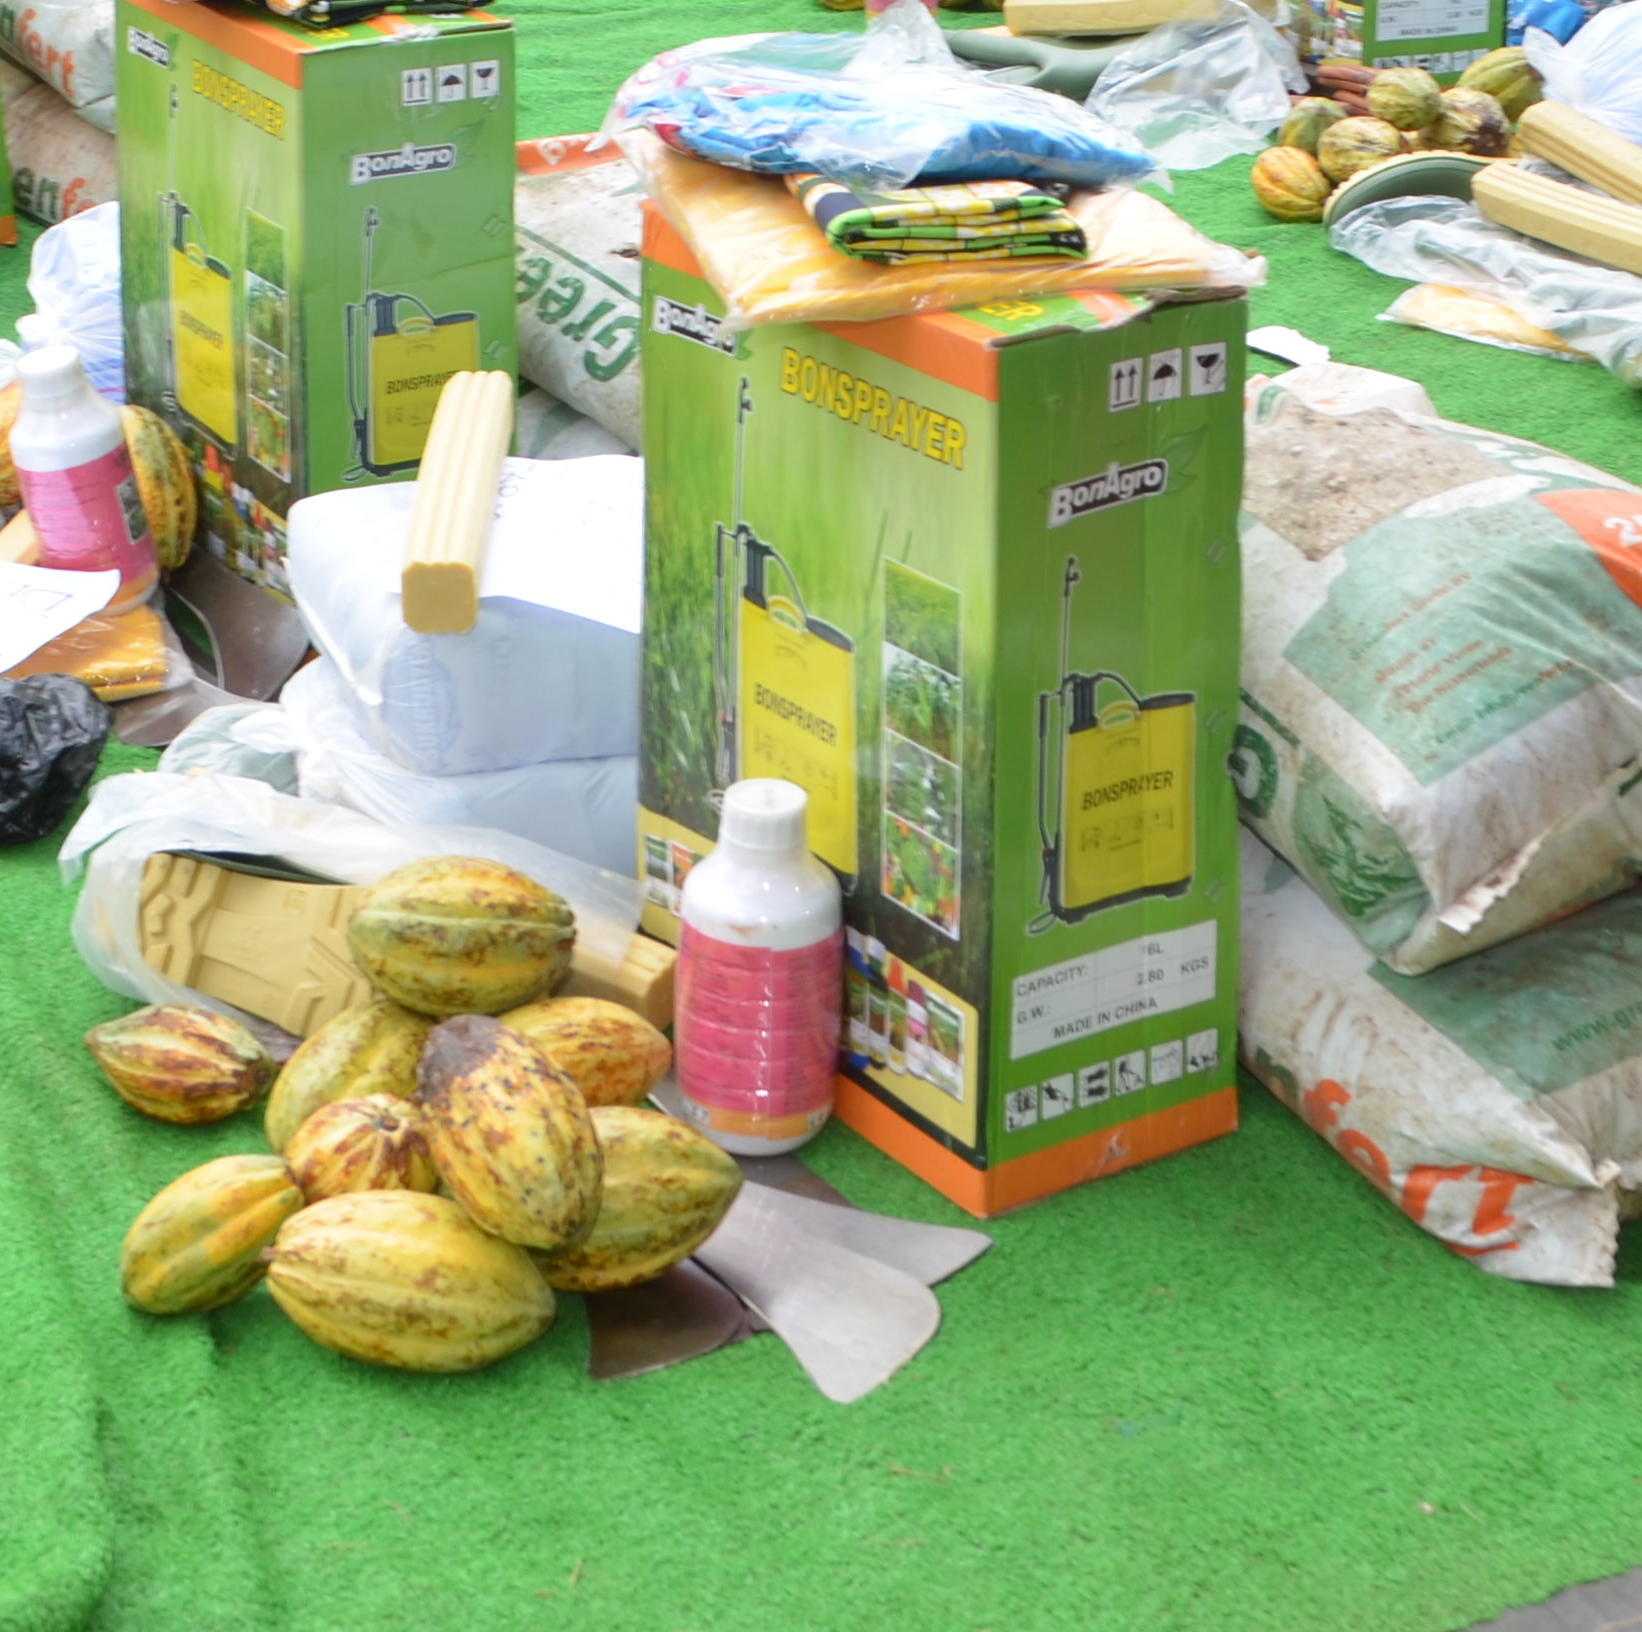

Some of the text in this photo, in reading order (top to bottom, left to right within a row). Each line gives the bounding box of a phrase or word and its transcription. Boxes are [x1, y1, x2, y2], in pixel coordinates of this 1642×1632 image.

[190, 59, 287, 141] BONSPRAYER
[349, 143, 457, 186] BonAgro
[654, 295, 740, 356] BonAgro
[781, 346, 967, 470] BONSPRAYER
[1048, 459, 1169, 530] BonAgro
[755, 681, 839, 748] BONSPRAYER
[1082, 769, 1175, 812] BONSPRAYER
[1015, 963, 1090, 1000] CAPACITY:
[1180, 955, 1211, 977] KGS
[1053, 996, 1159, 1040] MADE IN CHINA
